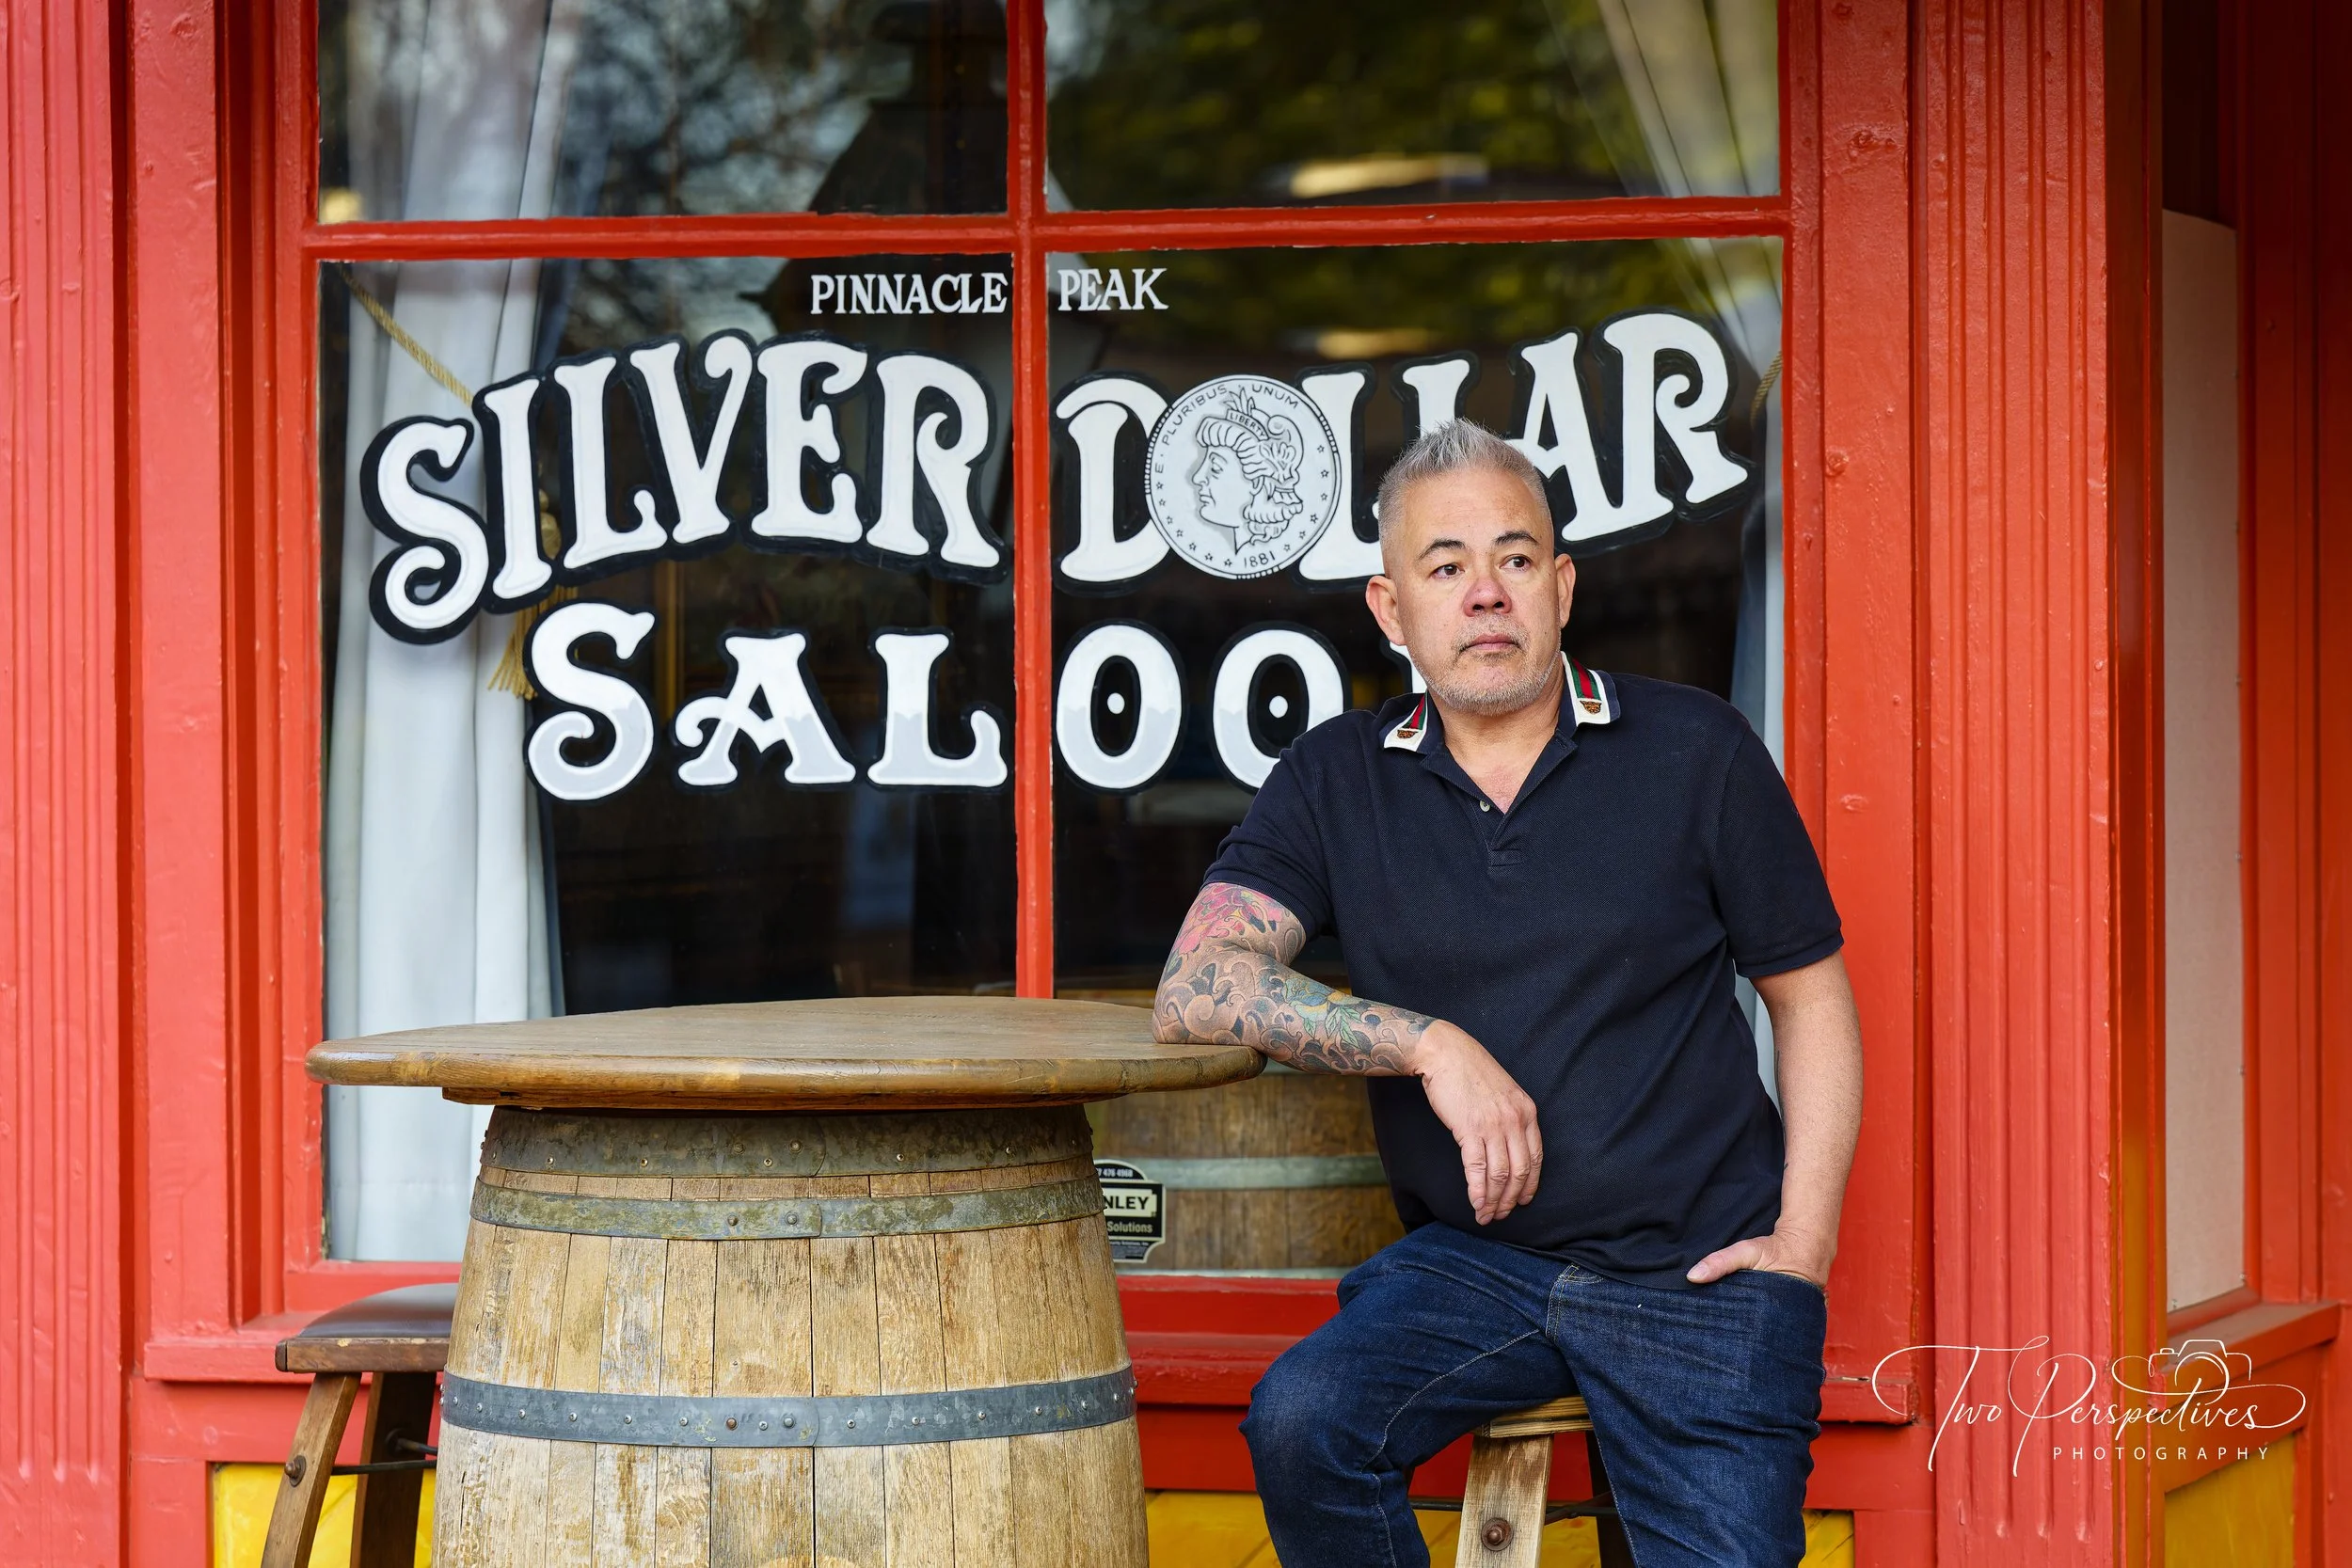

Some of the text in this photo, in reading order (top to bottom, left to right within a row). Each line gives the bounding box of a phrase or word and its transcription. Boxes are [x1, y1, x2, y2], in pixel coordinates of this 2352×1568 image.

[811, 268, 1168, 314] PINNACLE PEAK
[1163, 384, 1228, 447] PLURIBUS
[1251, 383, 1298, 409] UNUM
[1230, 412, 1265, 439] LIBERTY
[377, 336, 1000, 629] SILVER
[1244, 551, 1276, 568] 1881
[528, 603, 1427, 800] SALOO
[1106, 1221, 1153, 1234] Solutions
